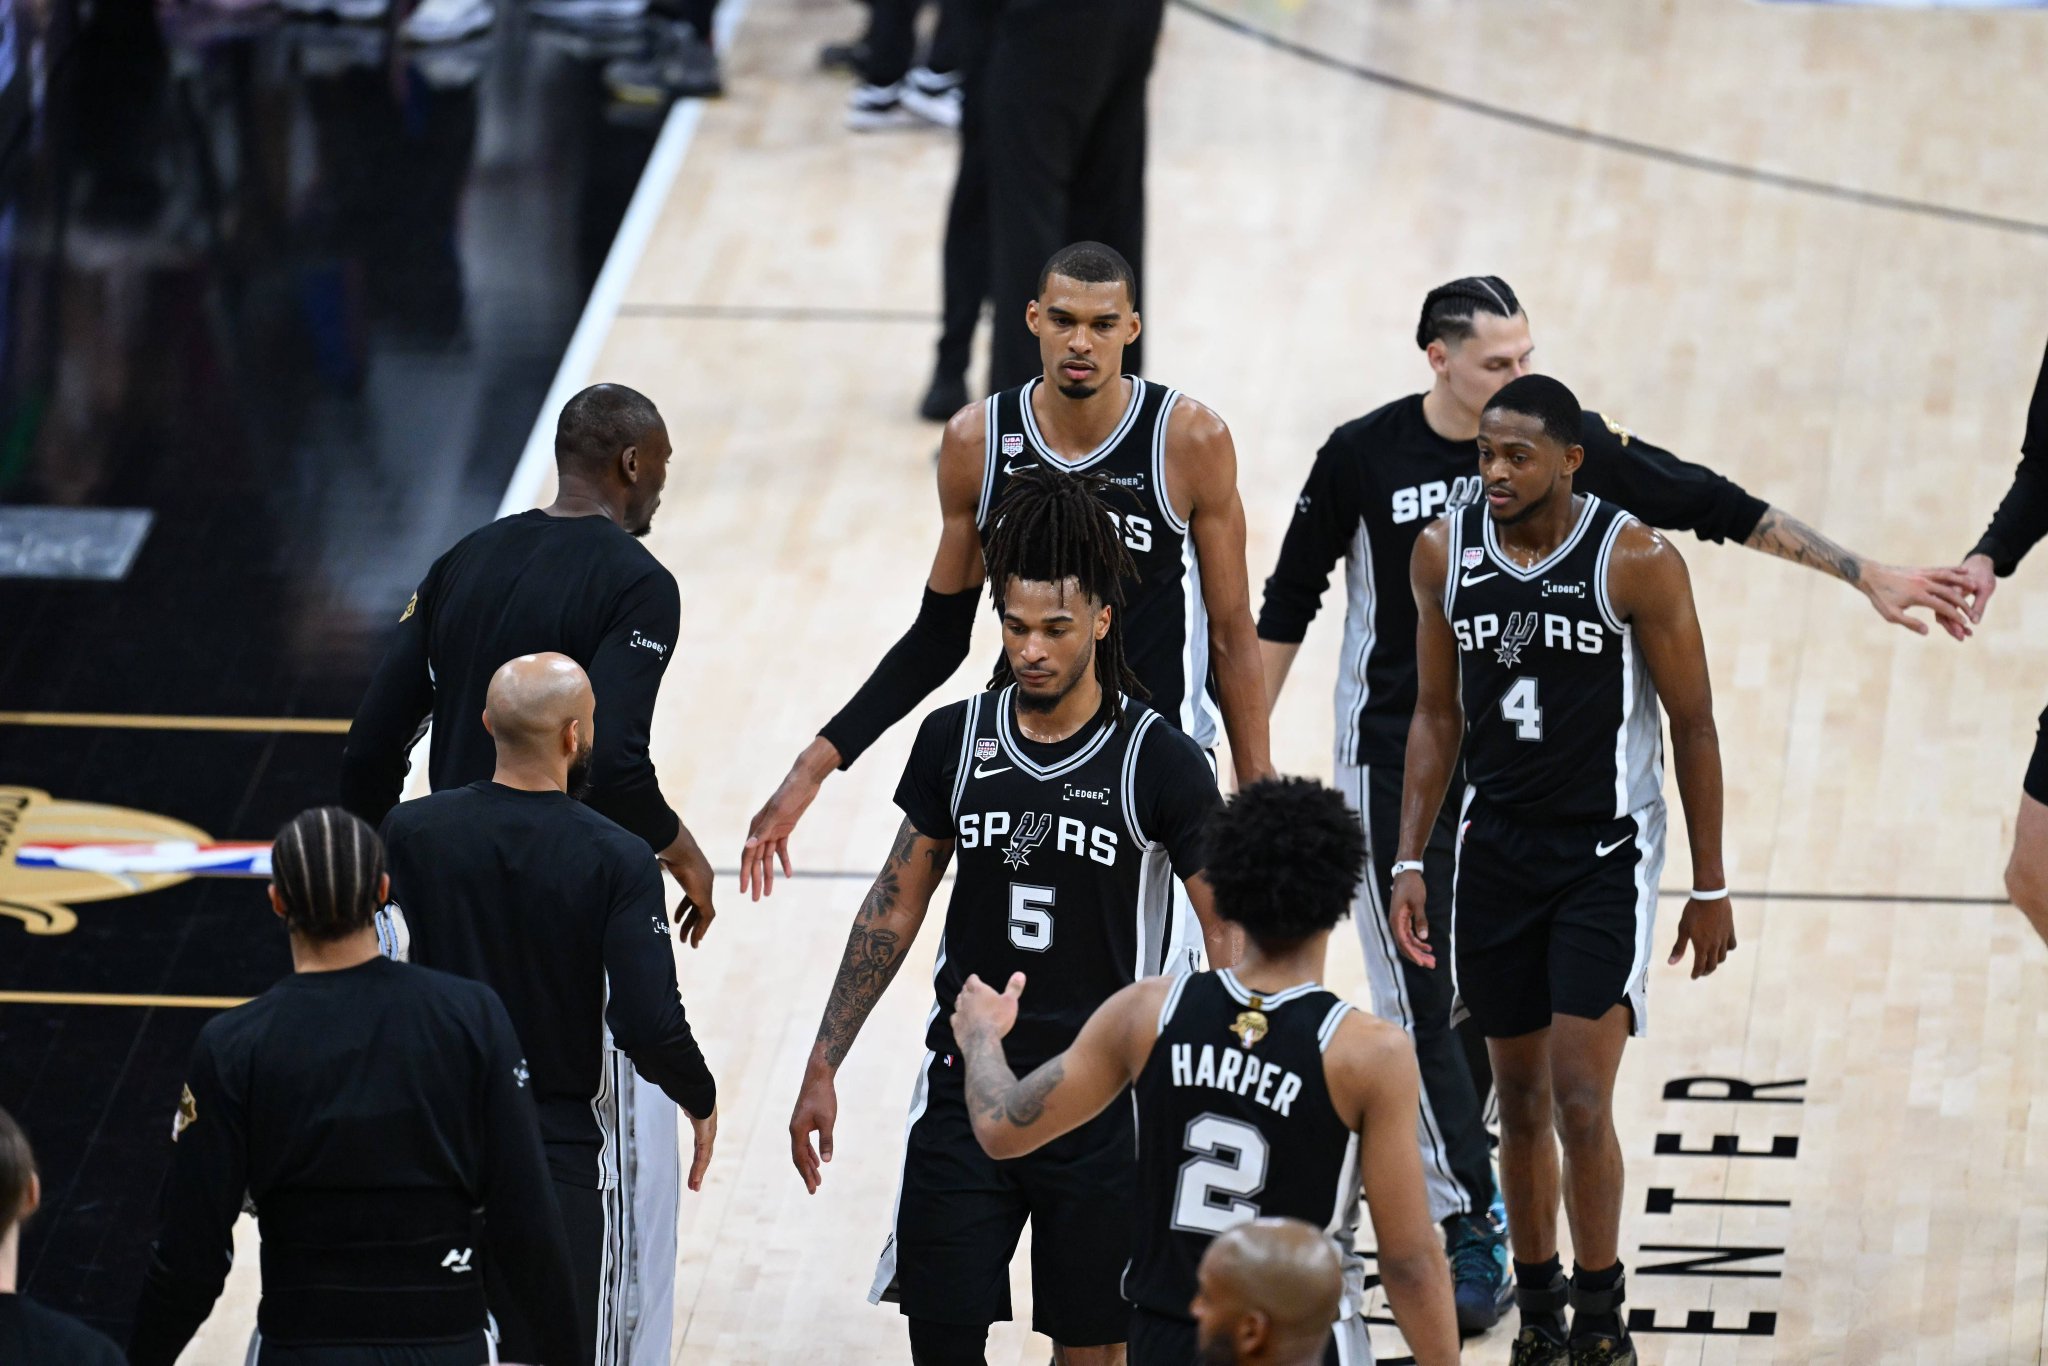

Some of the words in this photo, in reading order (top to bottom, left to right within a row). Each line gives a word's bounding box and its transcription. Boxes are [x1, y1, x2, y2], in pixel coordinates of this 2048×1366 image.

[1105, 477, 1139, 486] EDGER
[1547, 583, 1580, 594] LEDGER
[1500, 676, 1543, 742] 4
[1069, 788, 1104, 801] LEDGER
[1008, 882, 1056, 953] 5
[1171, 1043, 1302, 1117] HARPER
[1169, 1111, 1271, 1236] 2
